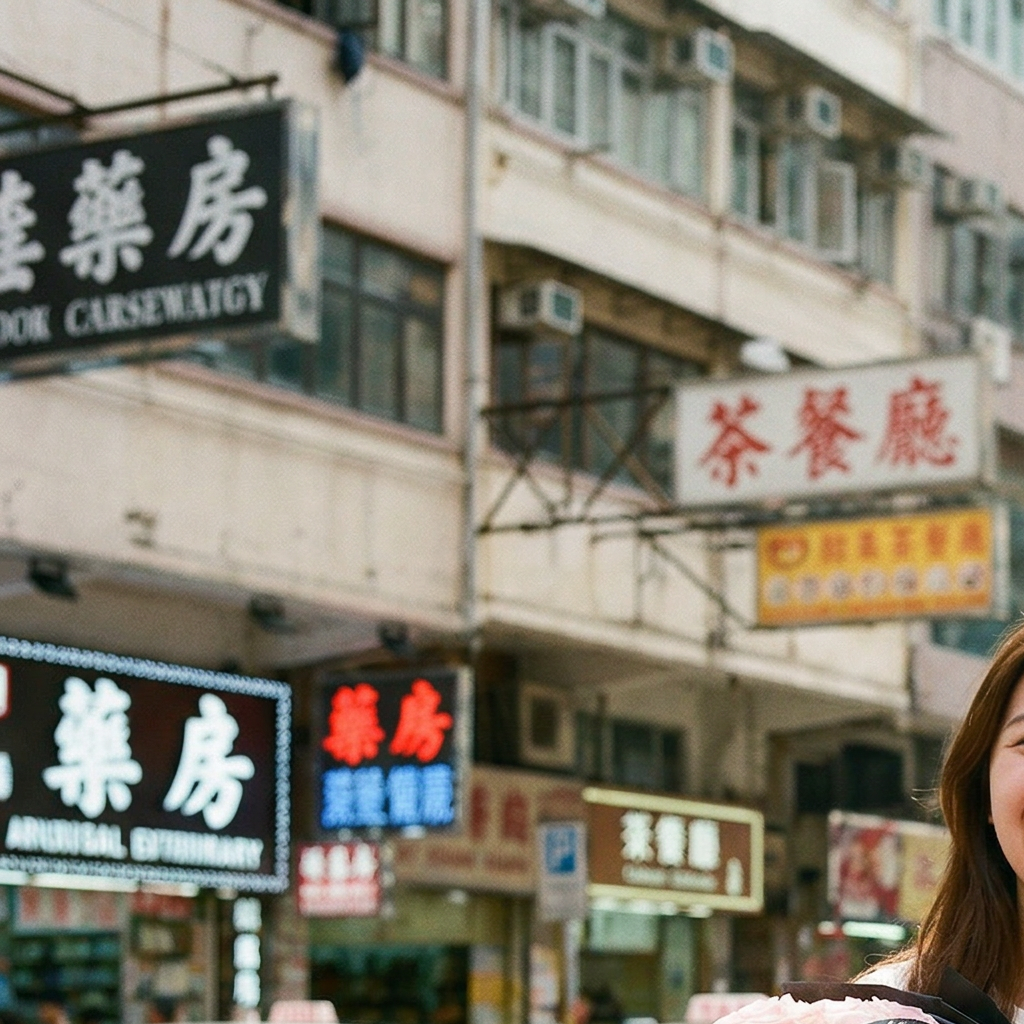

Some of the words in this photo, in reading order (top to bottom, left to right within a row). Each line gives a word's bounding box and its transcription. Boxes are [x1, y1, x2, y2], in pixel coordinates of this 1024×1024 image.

[699, 376, 960, 487] 茶餐廳
[0, 676, 255, 830] 藥房
